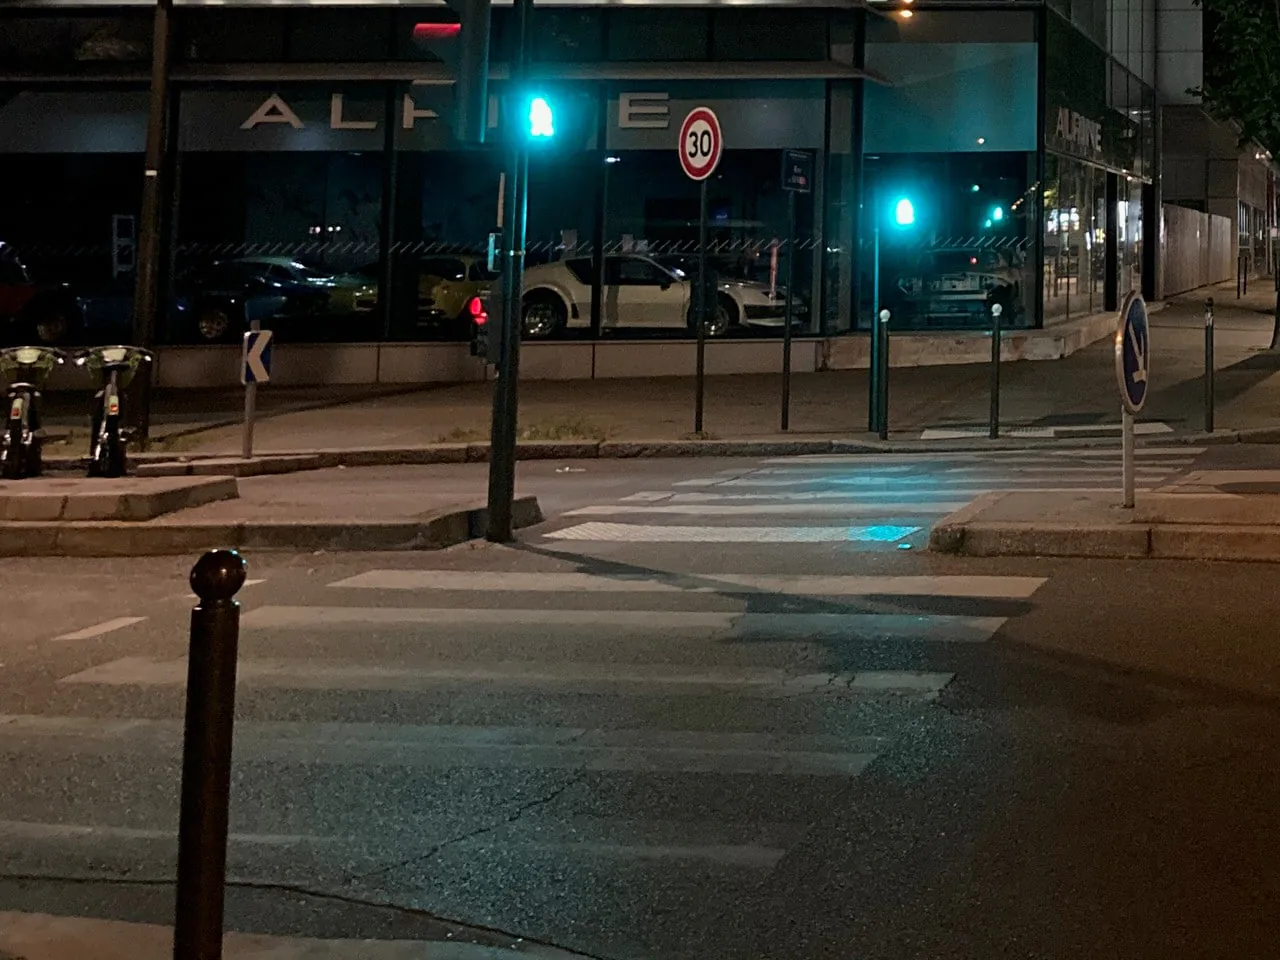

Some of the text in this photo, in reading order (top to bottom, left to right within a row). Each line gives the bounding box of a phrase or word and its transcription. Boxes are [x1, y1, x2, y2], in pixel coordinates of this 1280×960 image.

[240, 92, 671, 130] ALIE
[1056, 107, 1102, 152] ALPINE
[688, 130, 712, 158] 30
